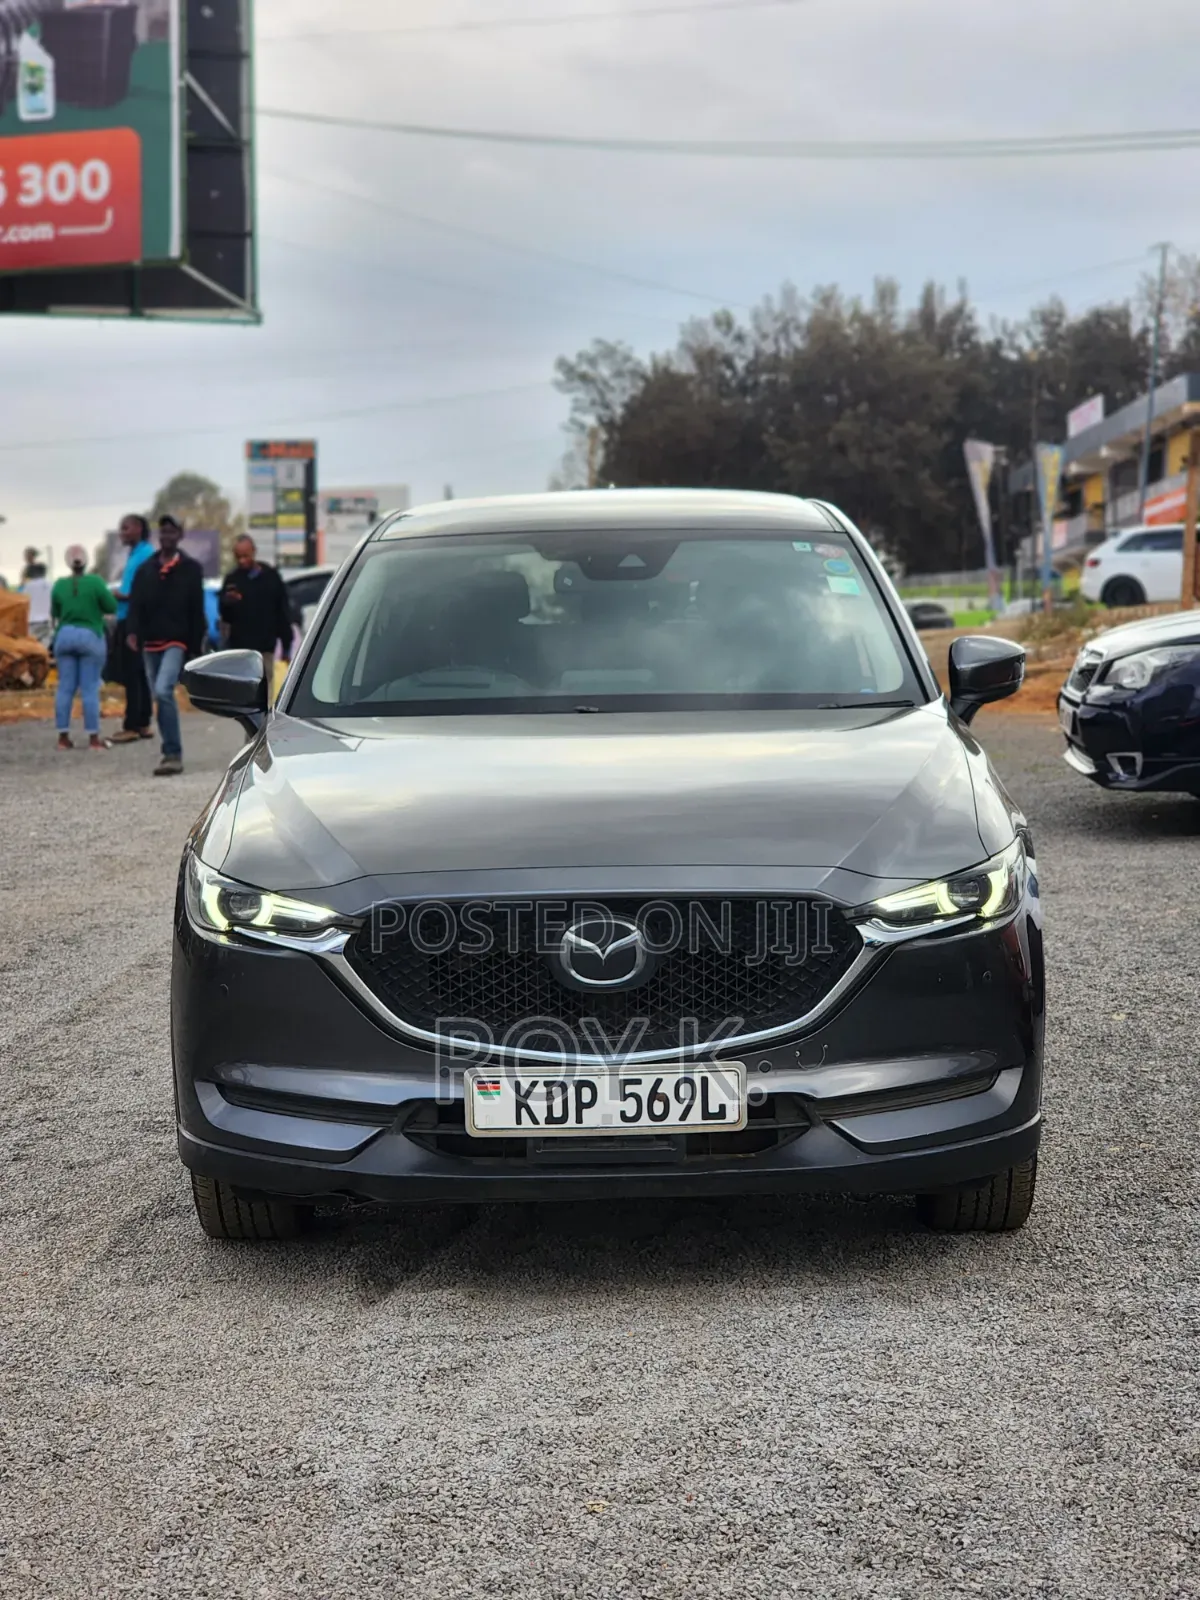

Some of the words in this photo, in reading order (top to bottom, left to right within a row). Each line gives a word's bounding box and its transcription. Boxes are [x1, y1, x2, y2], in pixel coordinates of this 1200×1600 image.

[17, 158, 111, 207] 300
[514, 1079, 598, 1126] KDP
[619, 1075, 727, 1123] 569L
